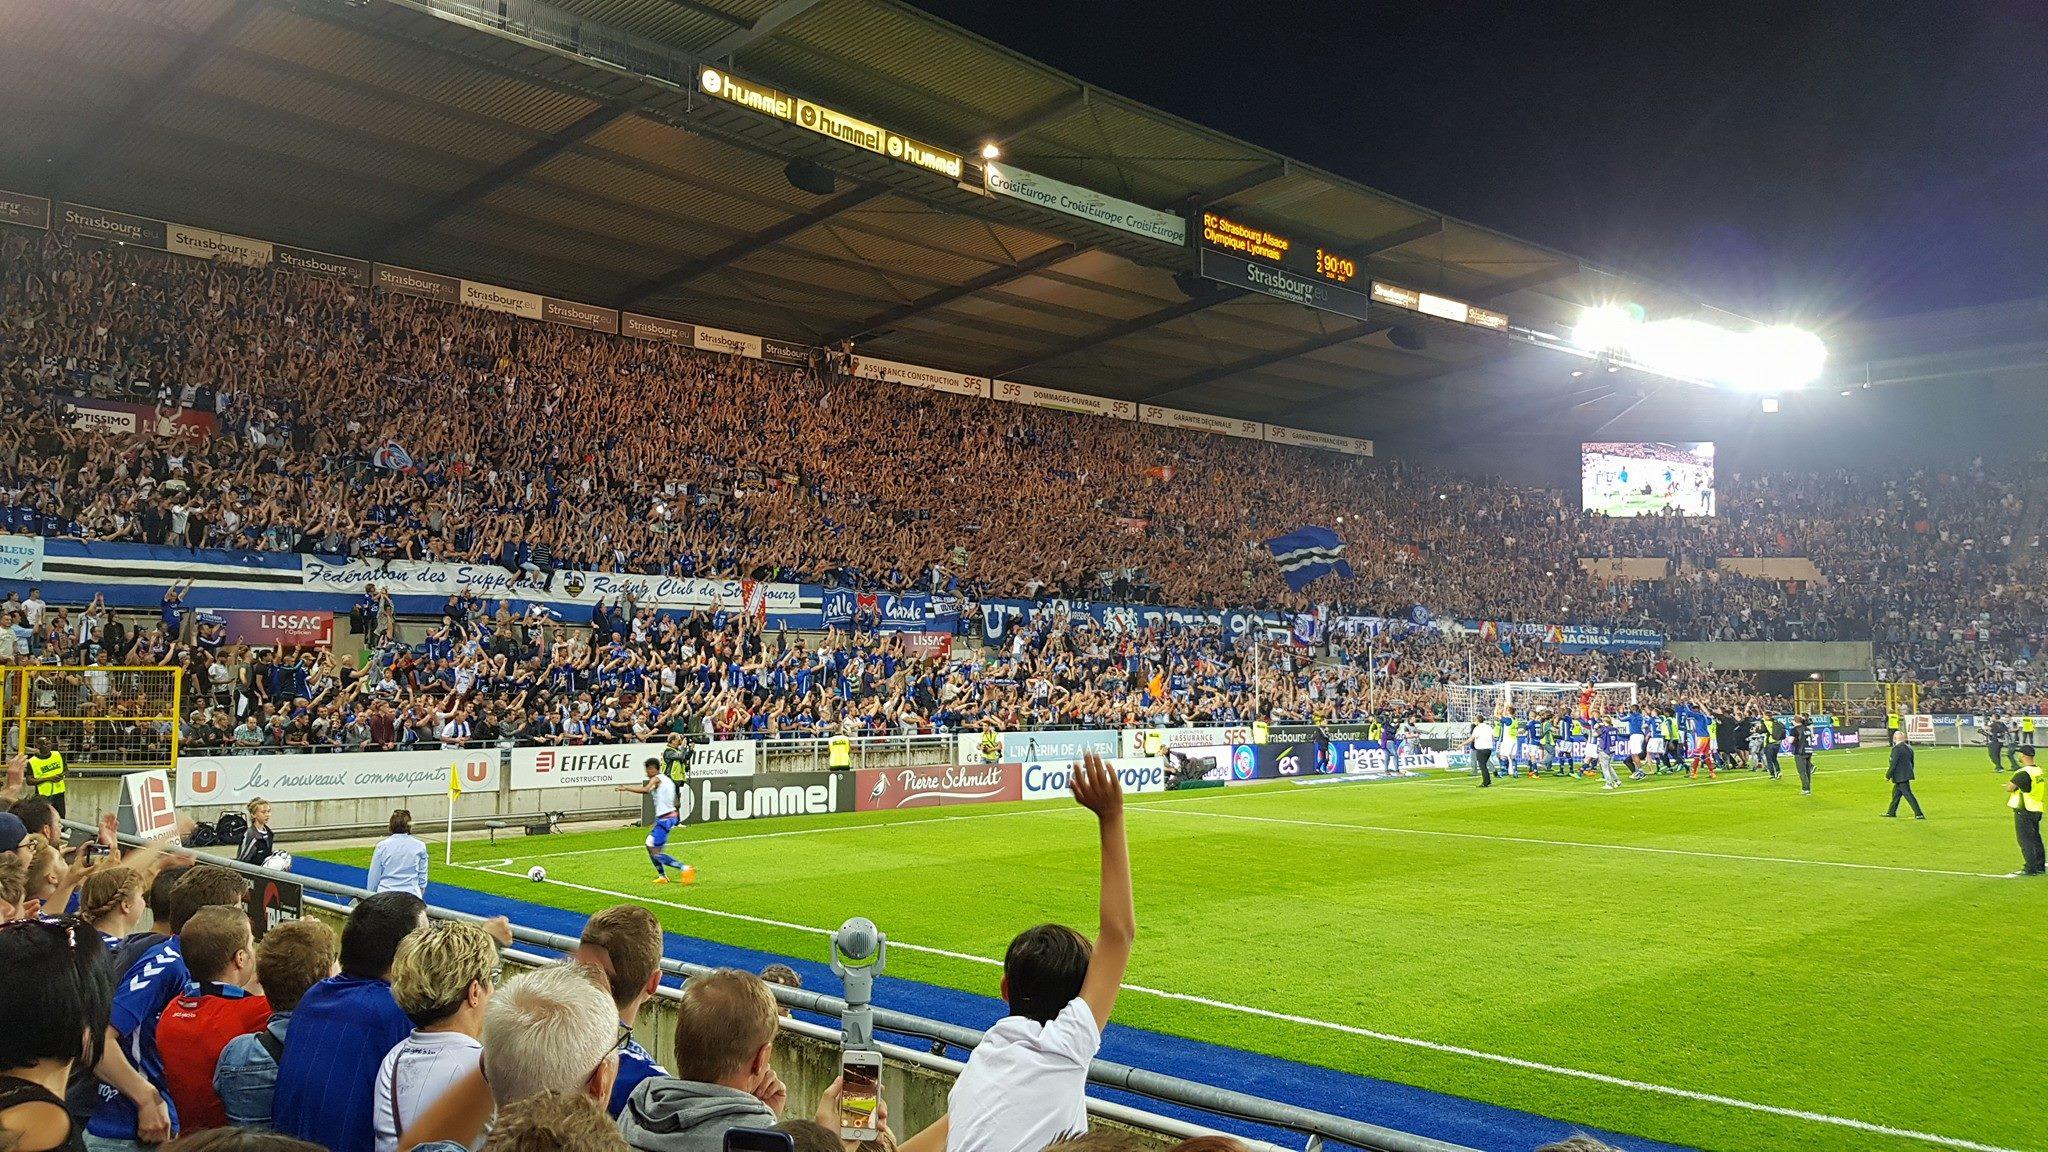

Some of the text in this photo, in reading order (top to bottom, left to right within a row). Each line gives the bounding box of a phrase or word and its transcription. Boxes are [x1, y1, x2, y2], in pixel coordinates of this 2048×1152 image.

[724, 76, 792, 119] hummel
[819, 112, 880, 150] hummel
[905, 141, 960, 177] hummel
[990, 175, 1184, 241] CroisiEurope CroisiEurope CroisiEurope
[1203, 213, 1288, 250] RC Strasbourg Alsace
[1203, 228, 1281, 260] Olympique Lyonnais
[1316, 249, 1322, 260] 3
[1316, 262, 1322, 273] 2
[1324, 255, 1353, 277] 90:00
[864, 363, 982, 390] ASSURANCE CONSTRUCTION SFS
[1002, 383, 1021, 396] SFS
[1112, 401, 1129, 413] SFS
[77, 413, 131, 427] PTISSIMO
[143, 419, 200, 437] LISAC
[1147, 407, 1163, 419] SFS
[1173, 413, 1200, 424] GARANTIE
[1242, 422, 1256, 434] SFS
[1272, 426, 1285, 438] SFS
[1354, 440, 1367, 451] SFS
[305, 562, 408, 583] Fédération
[417, 566, 447, 583] des
[592, 577, 798, 605] Racing Club de Strbourg
[261, 615, 321, 630] LISSAC
[913, 635, 945, 646] LISSAC
[1061, 743, 1074, 755] DE
[1076, 744, 1083, 754] A
[1094, 742, 1113, 754] ZEN
[1169, 734, 1213, 742] L'ASSURANCE
[1224, 729, 1246, 745] SFS
[560, 753, 632, 772] EIFFAGE
[691, 748, 745, 765] IFFAGE
[192, 770, 217, 794] U
[234, 763, 451, 791] les nouveaux commerçants
[466, 761, 487, 782] U
[560, 775, 613, 784] CONSTRUCTION
[897, 766, 1003, 790] Pierre Schmidt
[701, 773, 838, 821] hummel
